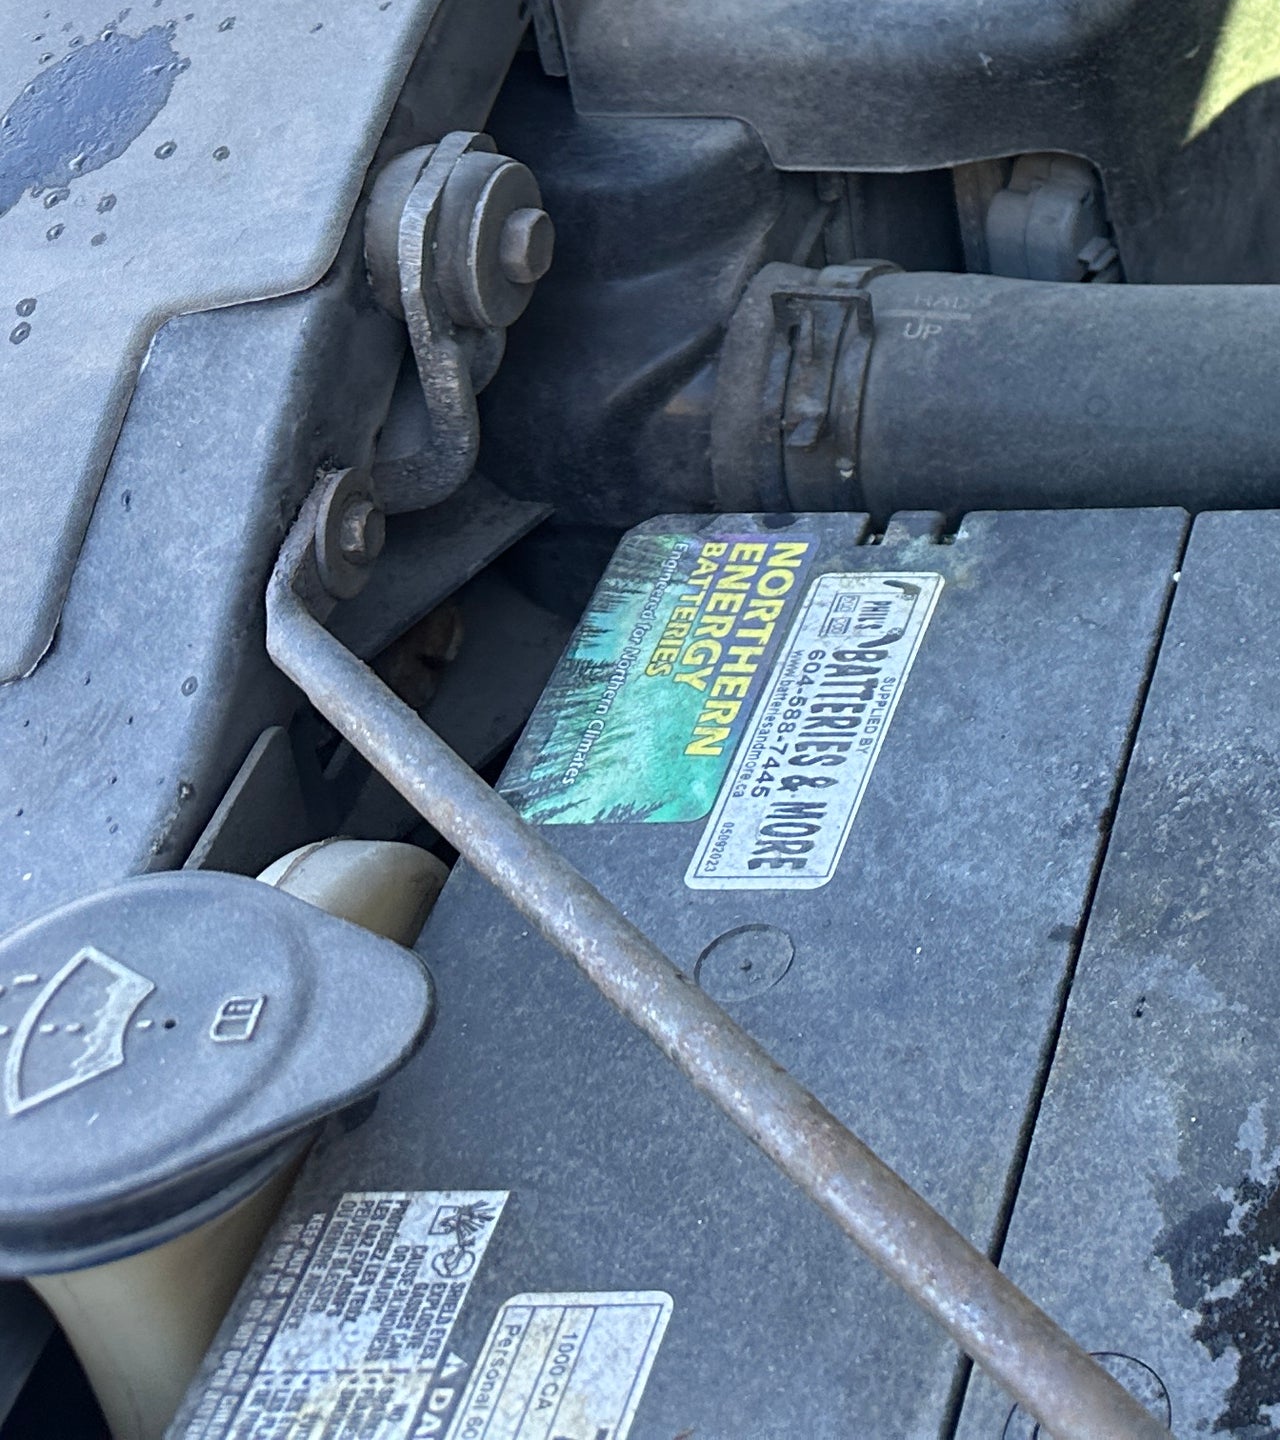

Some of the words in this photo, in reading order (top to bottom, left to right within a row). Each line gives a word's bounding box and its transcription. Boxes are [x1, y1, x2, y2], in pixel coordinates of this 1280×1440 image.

[902, 317, 943, 340] UP
[637, 542, 689, 619] Engineered
[643, 542, 728, 676] BATTERIES
[627, 623, 651, 643] for
[671, 542, 767, 691] ENERGY
[683, 542, 809, 756] NORTHERN
[593, 647, 641, 714] Northern
[787, 649, 890, 767] BATTERIES
[861, 676, 896, 733] SUPPLIED
[559, 719, 608, 785] Climates
[730, 650, 806, 797] www.batteriesandmore.ca
[748, 649, 827, 797] 604-588-7445
[854, 737, 873, 754] BY
[776, 775, 839, 793] &
[743, 801, 830, 872] MORE
[472, 1323, 522, 1410] Personal
[548, 1331, 579, 1377] 1000
[534, 1382, 560, 1412] CA
